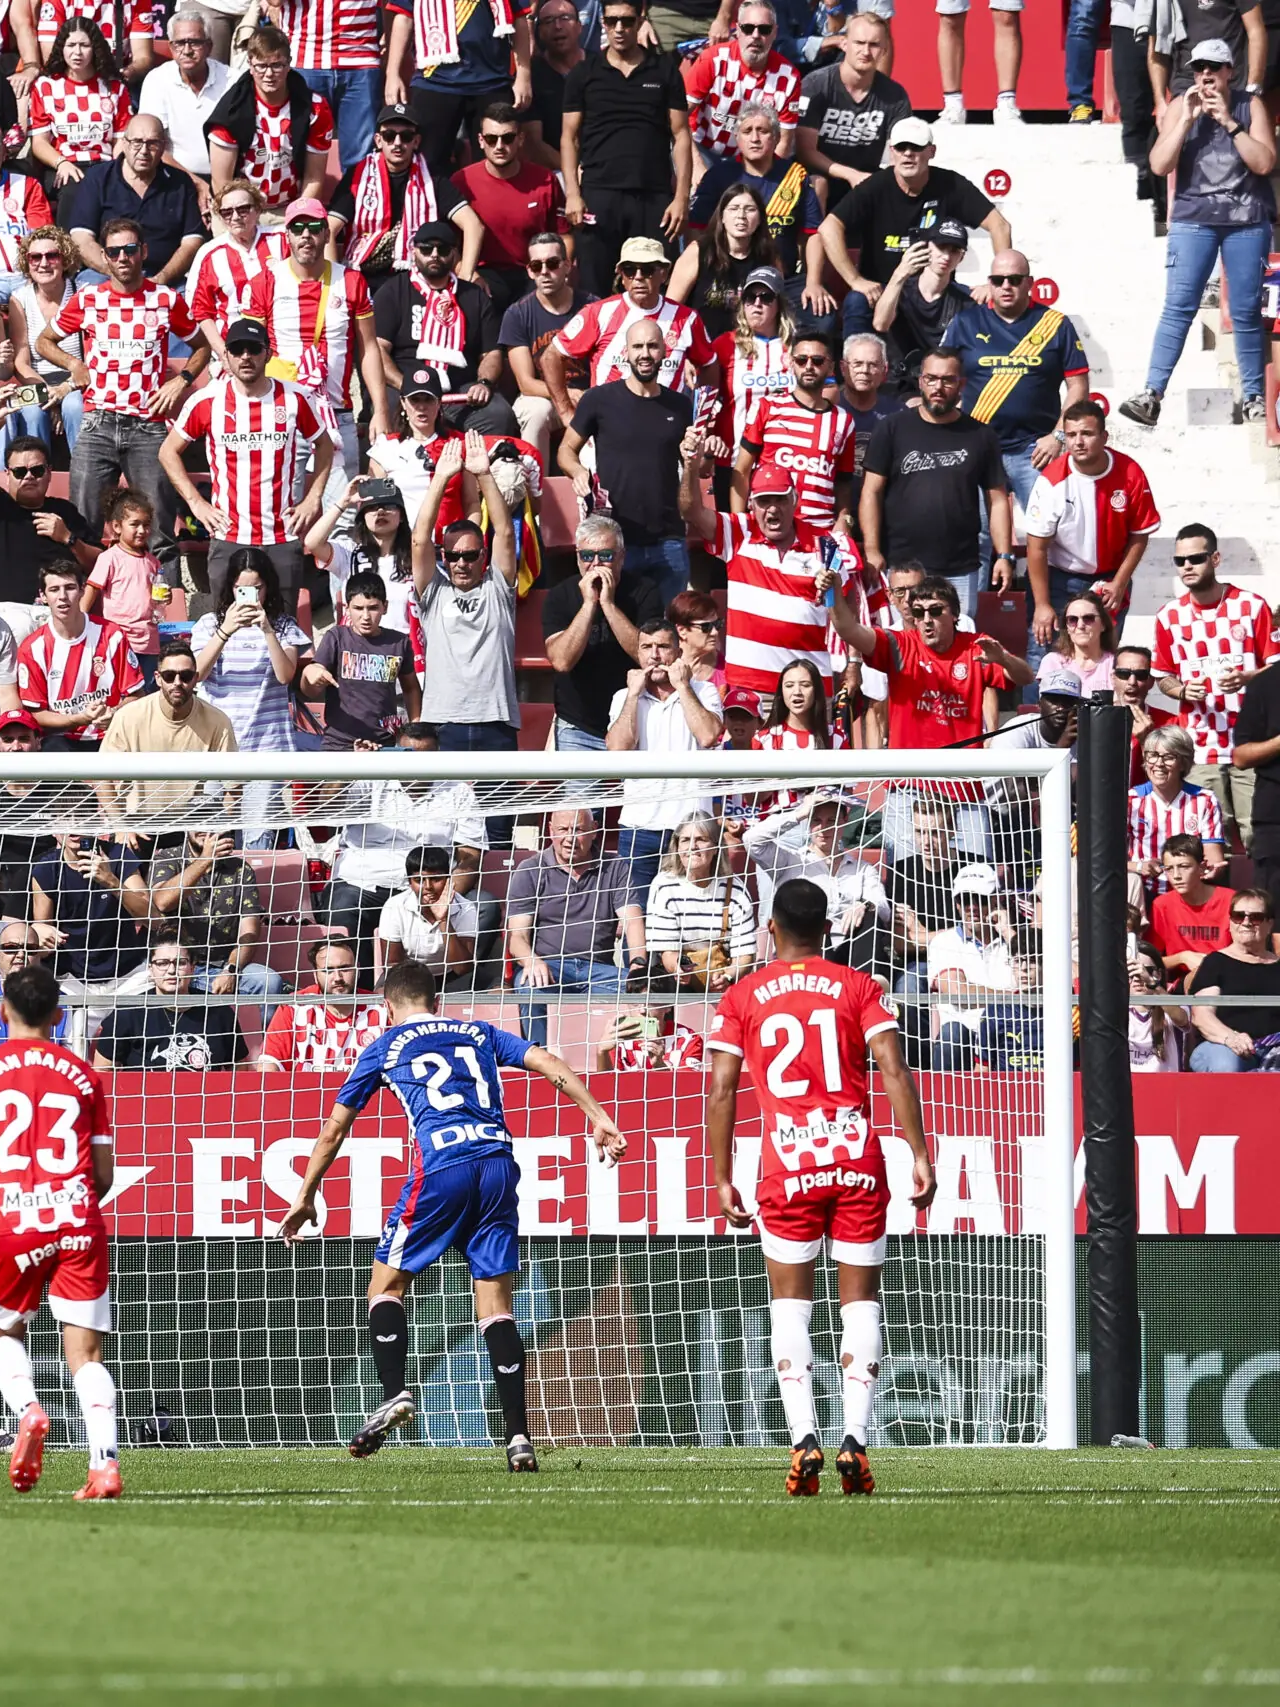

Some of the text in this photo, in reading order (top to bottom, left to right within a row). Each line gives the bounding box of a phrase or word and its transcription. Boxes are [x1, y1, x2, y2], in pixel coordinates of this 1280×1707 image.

[57, 122, 111, 133] ETIHAD
[823, 109, 885, 132] PROG
[988, 176, 1007, 191] 12
[1037, 283, 1053, 299] 11
[978, 355, 1043, 367] ETIHAD
[741, 371, 795, 387] Gosbi
[221, 432, 290, 442] MARATHON
[774, 448, 835, 476] Gosbi
[53, 688, 111, 710] MARATHON
[921, 689, 965, 704] ANIMAL
[753, 973, 843, 1004] HERRERA
[416, 1022, 487, 1047] HERRERA
[383, 1028, 420, 1070] ANDER
[759, 1008, 843, 1099] 21
[411, 1046, 491, 1111] 21
[779, 1121, 851, 1144] Marlex
[800, 1167, 877, 1194] parlem
[4, 1190, 76, 1209] Marlex
[30, 1235, 92, 1266] paem
